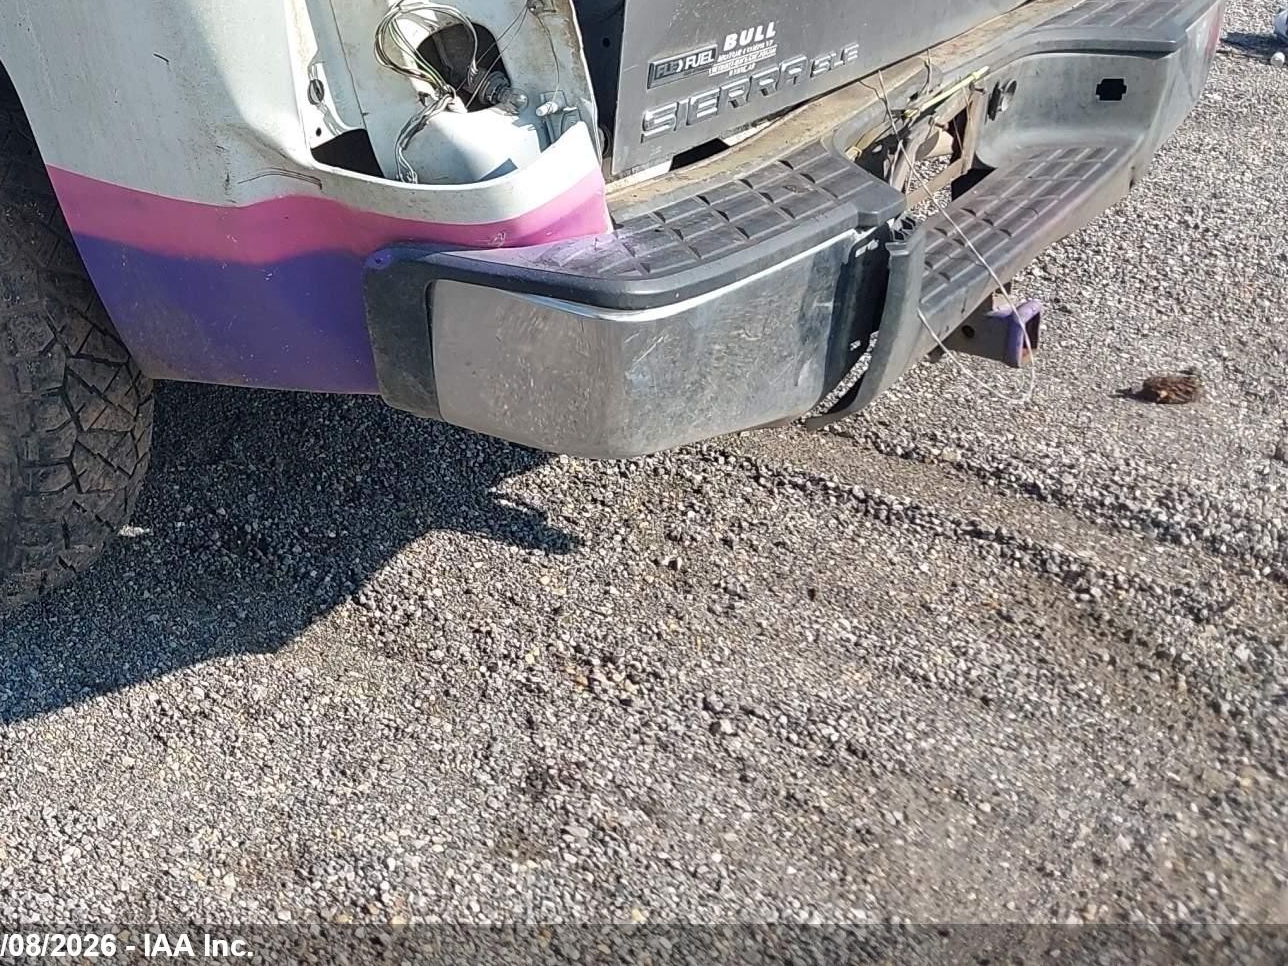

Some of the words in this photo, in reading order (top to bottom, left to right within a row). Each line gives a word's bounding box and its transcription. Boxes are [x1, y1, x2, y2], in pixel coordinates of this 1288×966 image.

[723, 21, 776, 51] BULL
[641, 55, 808, 141] SIERRA
[810, 42, 860, 78] SLE
